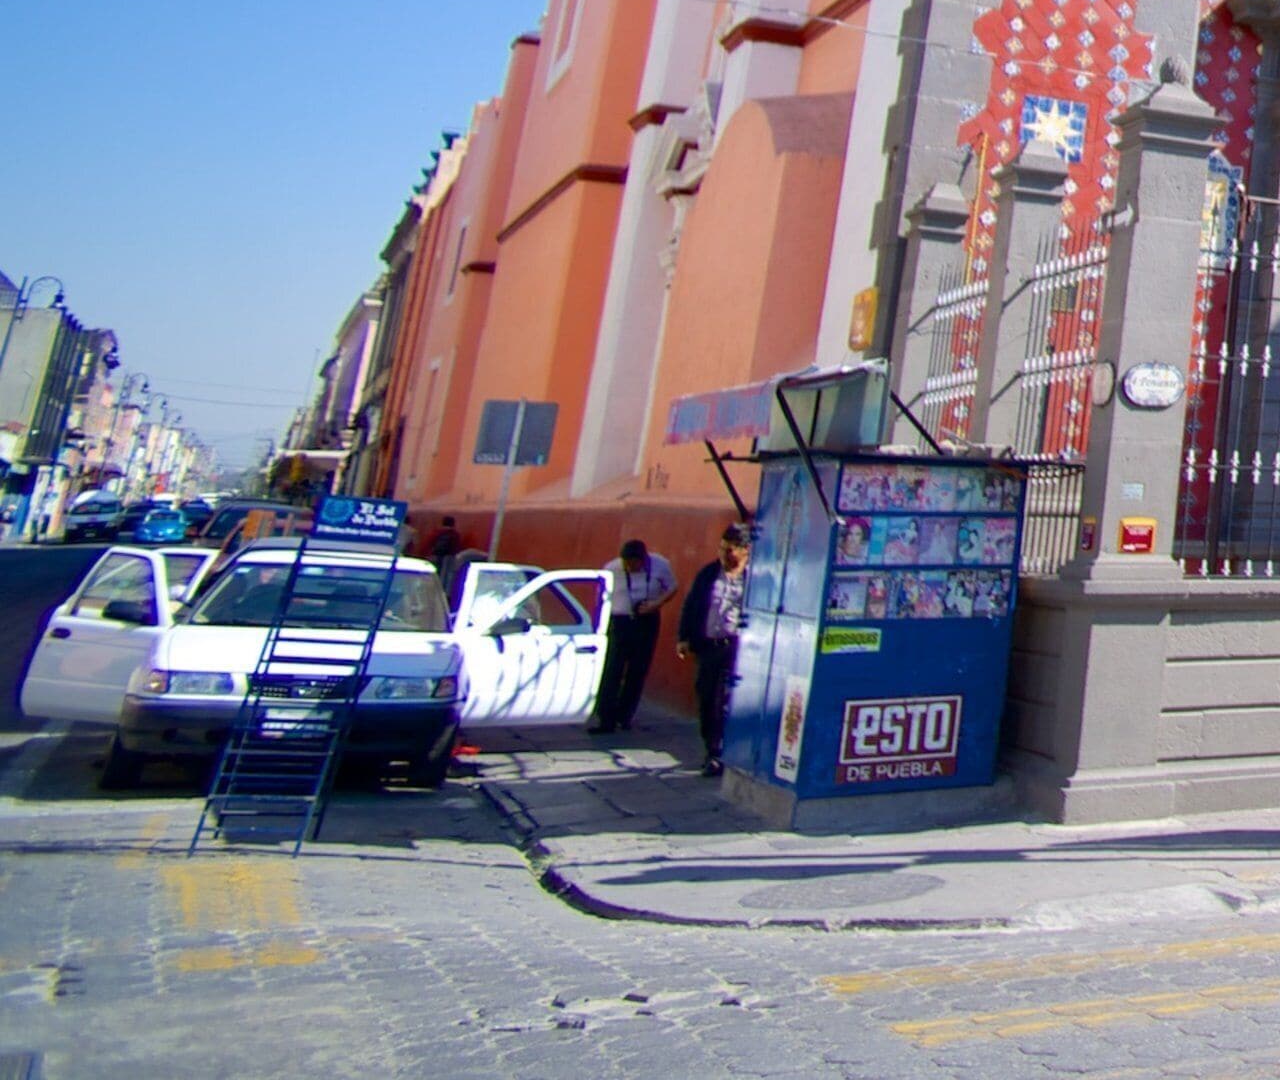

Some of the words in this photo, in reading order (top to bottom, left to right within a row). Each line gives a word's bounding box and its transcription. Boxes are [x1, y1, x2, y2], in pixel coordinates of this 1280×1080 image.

[852, 702, 951, 755] ESTO
[846, 766, 871, 782] DE
[876, 760, 943, 779] PUEBLA
